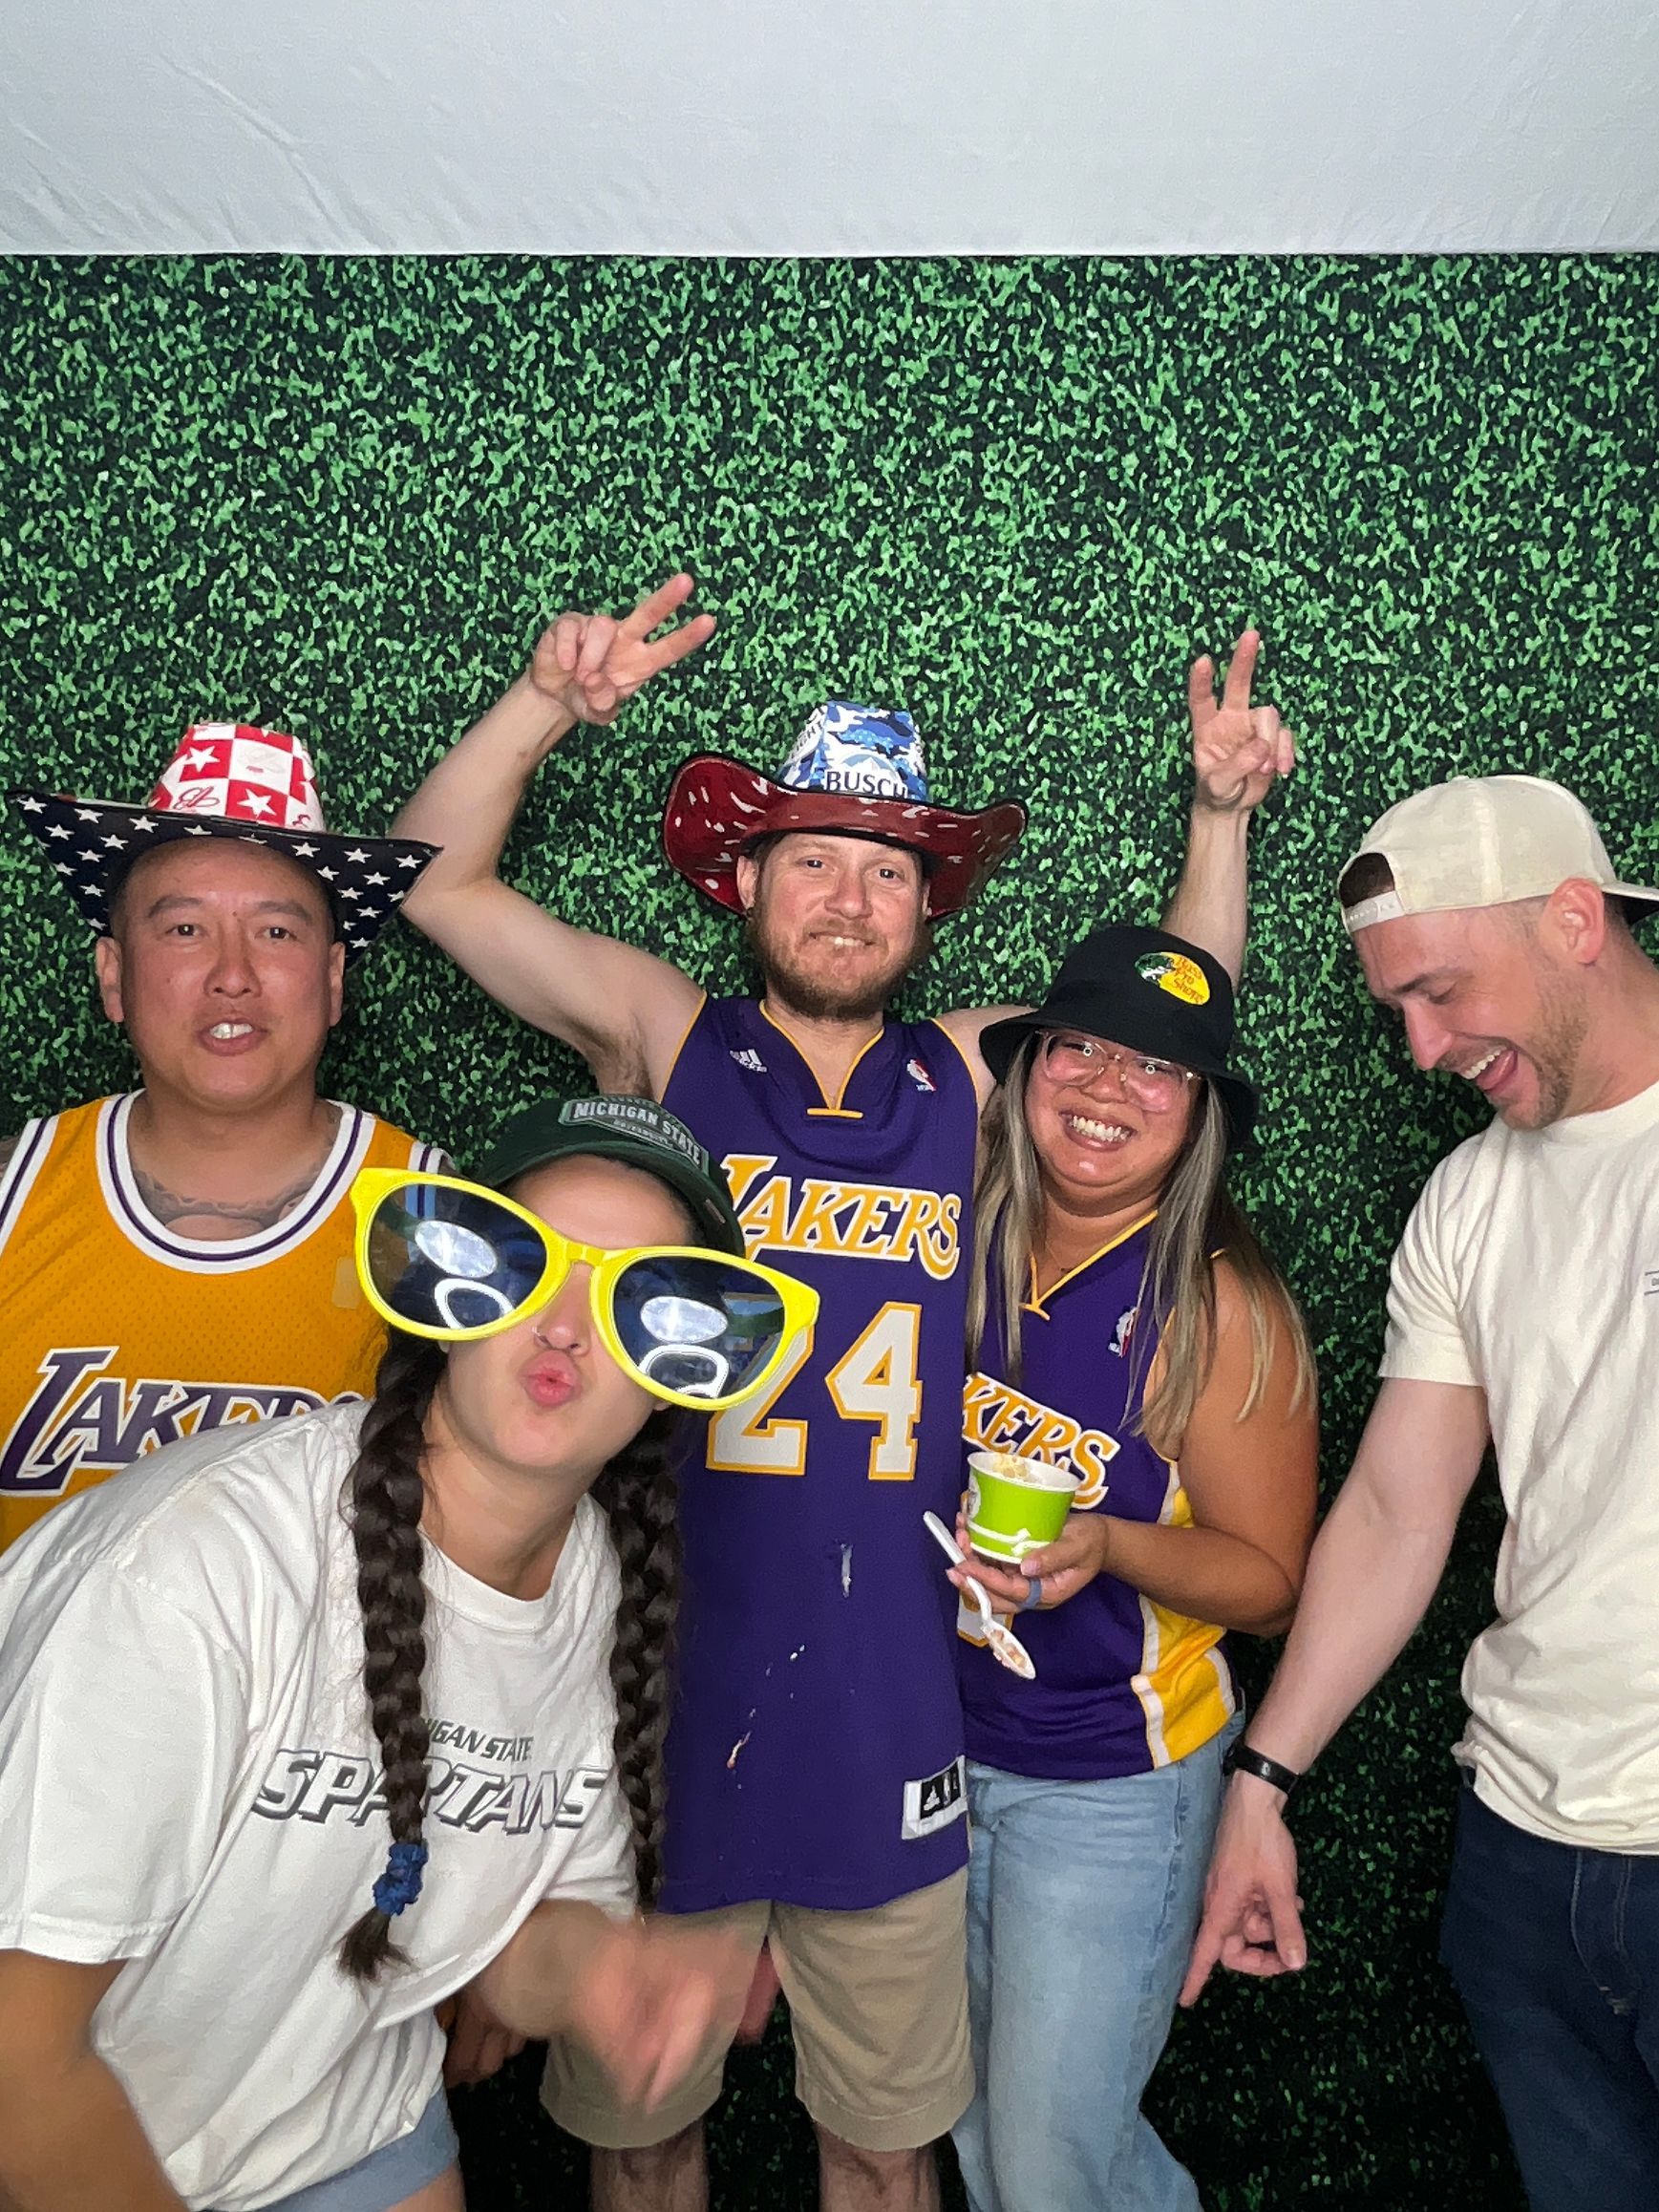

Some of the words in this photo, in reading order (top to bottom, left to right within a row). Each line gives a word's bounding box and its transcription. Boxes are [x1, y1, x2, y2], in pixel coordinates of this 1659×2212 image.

[574, 1101, 659, 1126] MICHIGAN
[661, 1119, 702, 1166] STATE
[720, 1154, 962, 1281] LAKERS
[961, 1372, 1121, 1510] KERS
